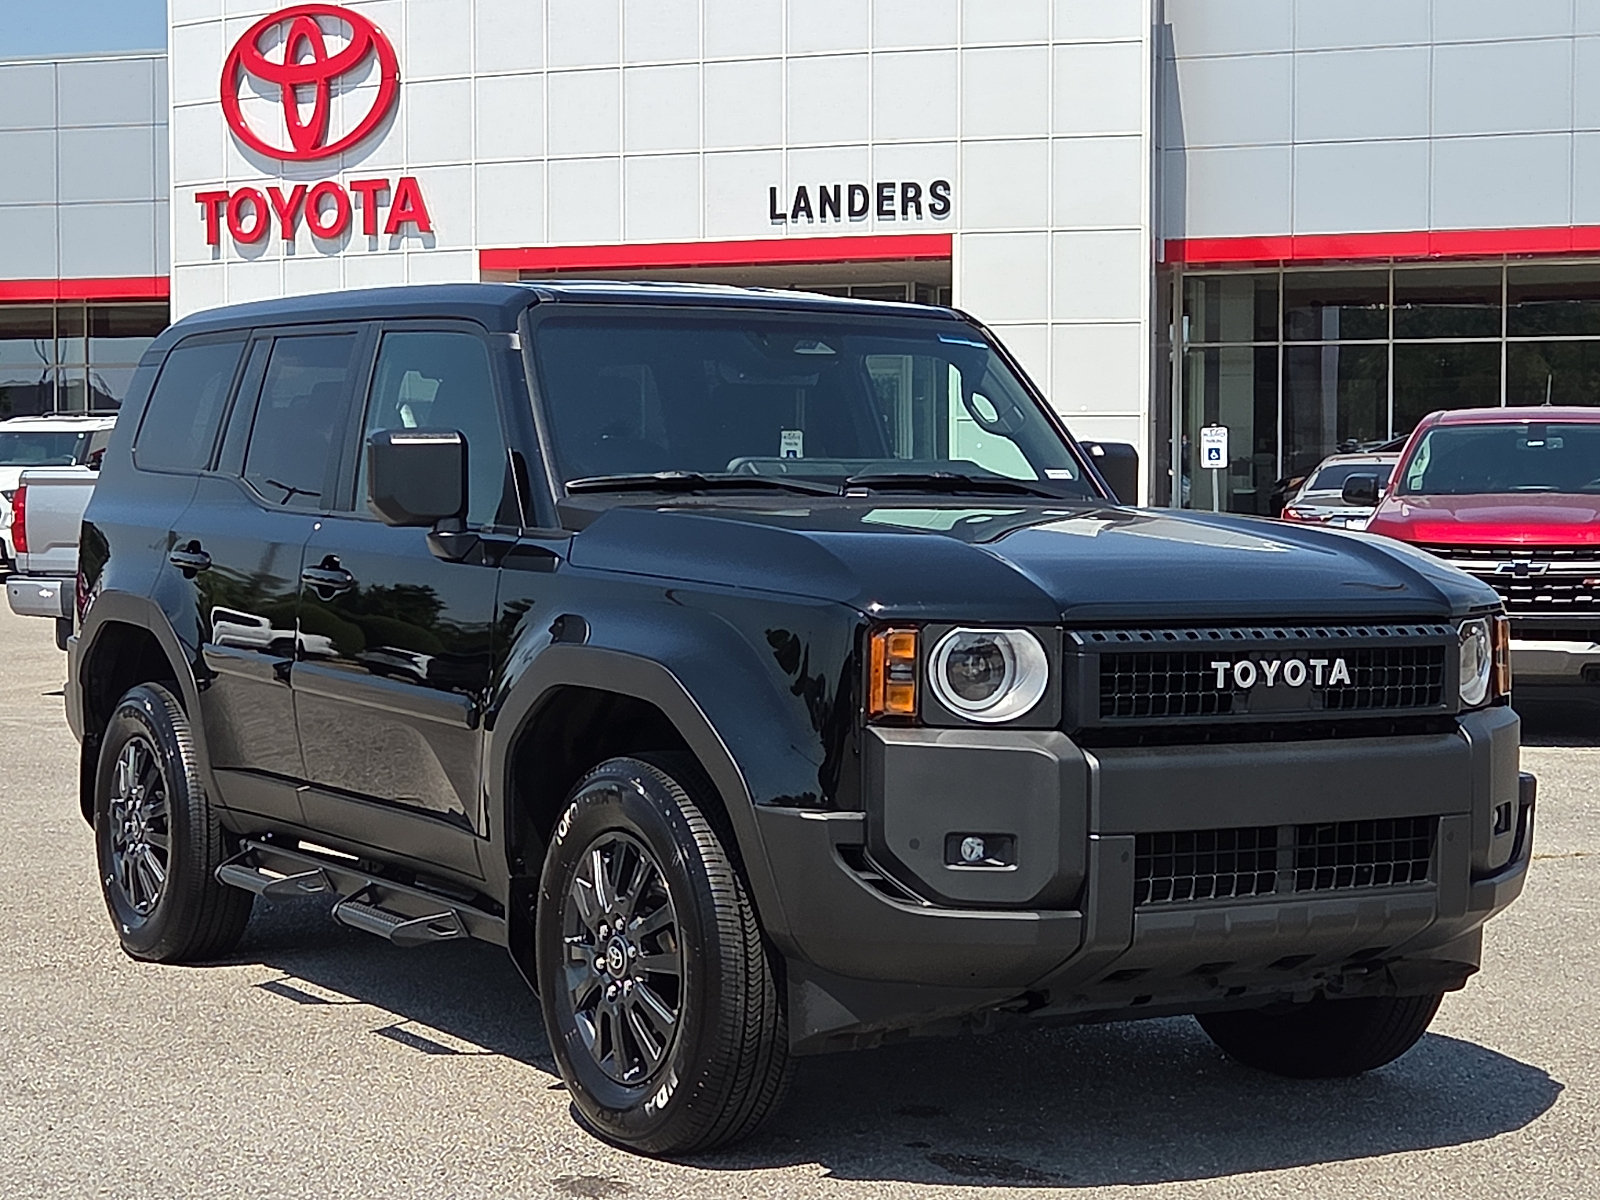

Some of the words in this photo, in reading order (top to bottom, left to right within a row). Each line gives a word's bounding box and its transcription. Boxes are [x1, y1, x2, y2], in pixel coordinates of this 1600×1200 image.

[195, 177, 434, 246] TOYOTA
[769, 180, 951, 220] LANDERS
[1210, 658, 1351, 689] TOYOTA
